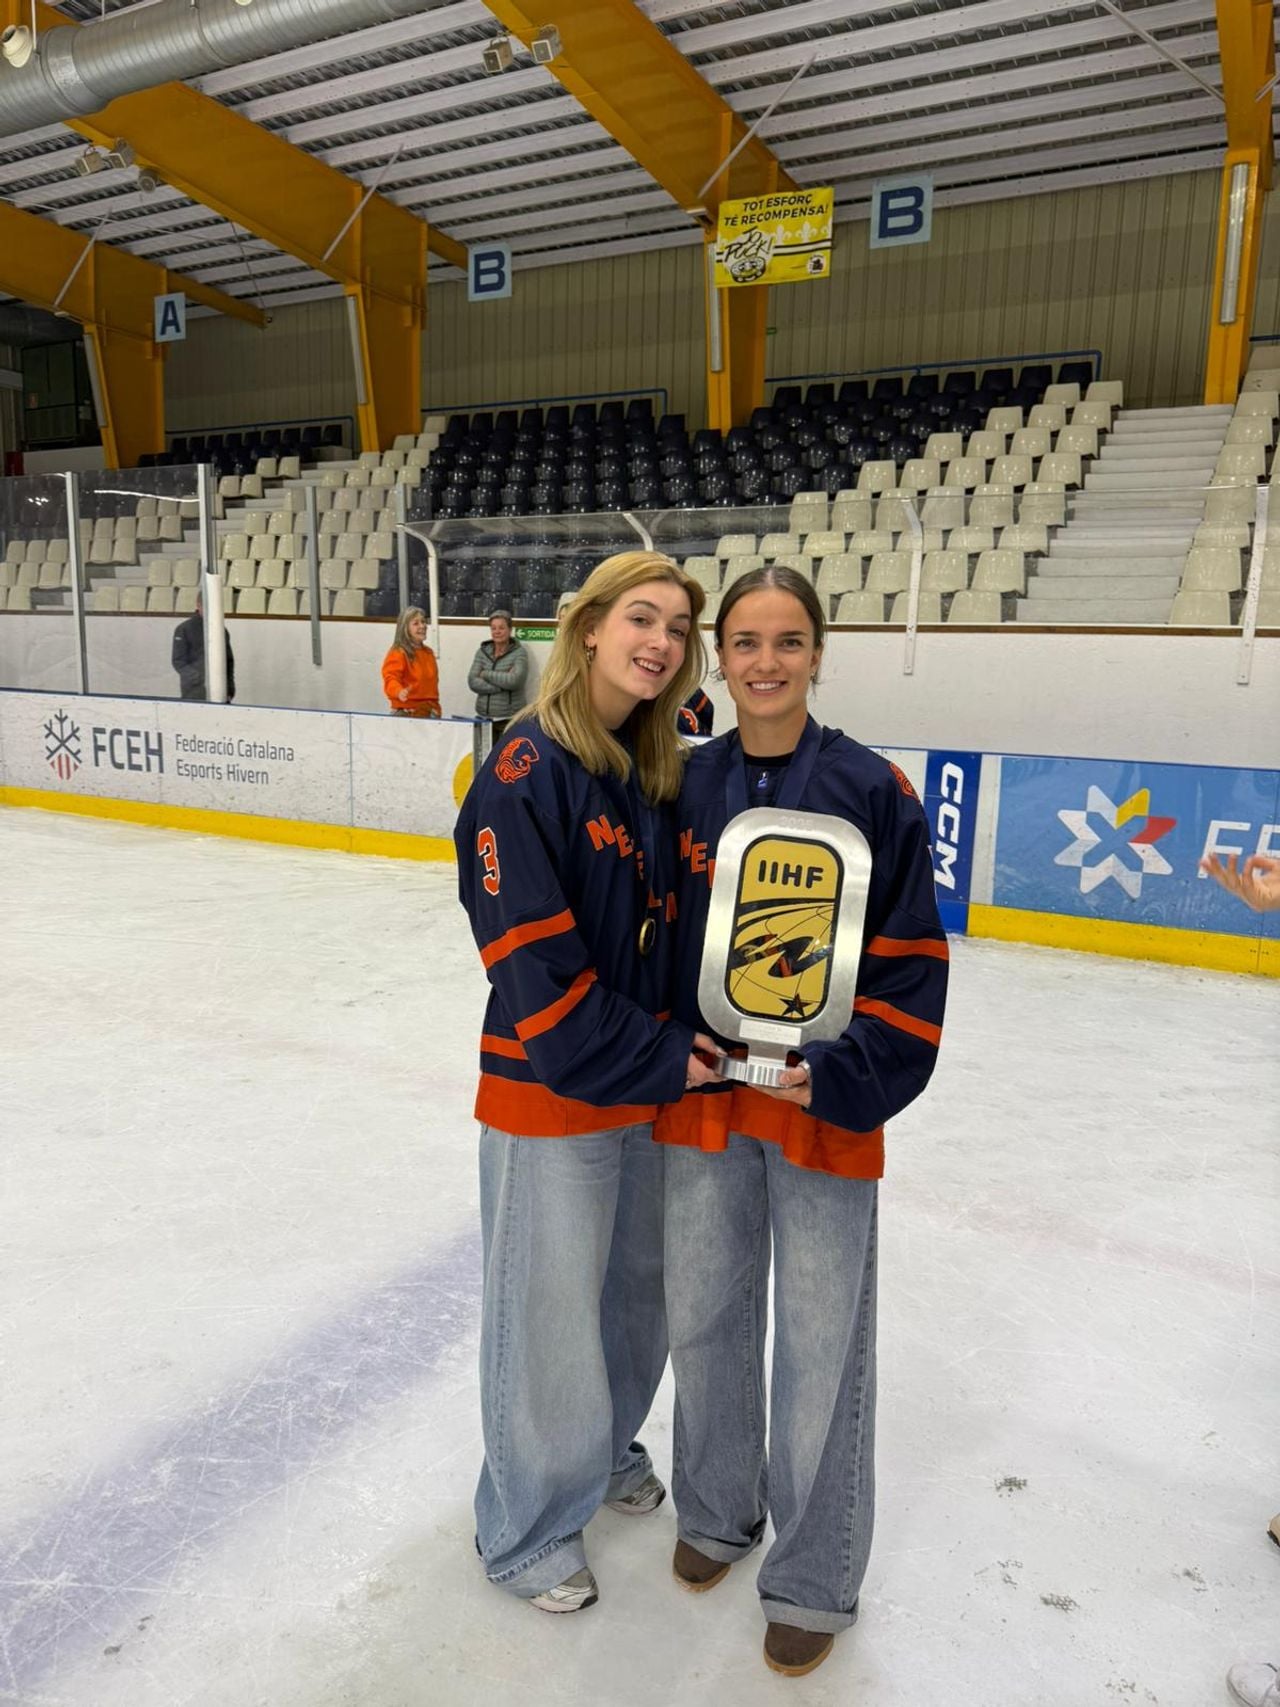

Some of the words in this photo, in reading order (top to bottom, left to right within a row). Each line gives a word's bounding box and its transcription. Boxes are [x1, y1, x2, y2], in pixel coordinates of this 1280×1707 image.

[741, 204, 829, 225] RECOMPENSA!
[743, 199, 765, 212] TOT
[878, 186, 924, 238] B
[474, 250, 505, 294] B
[160, 301, 181, 335] A
[92, 727, 164, 774] FCEH
[175, 734, 234, 756] Federació
[237, 739, 295, 761] Catalana
[176, 759, 223, 781] Esports
[227, 765, 269, 785] Hivern
[934, 761, 964, 890] CCM
[477, 826, 500, 896] 3
[758, 859, 824, 889] IIHF
